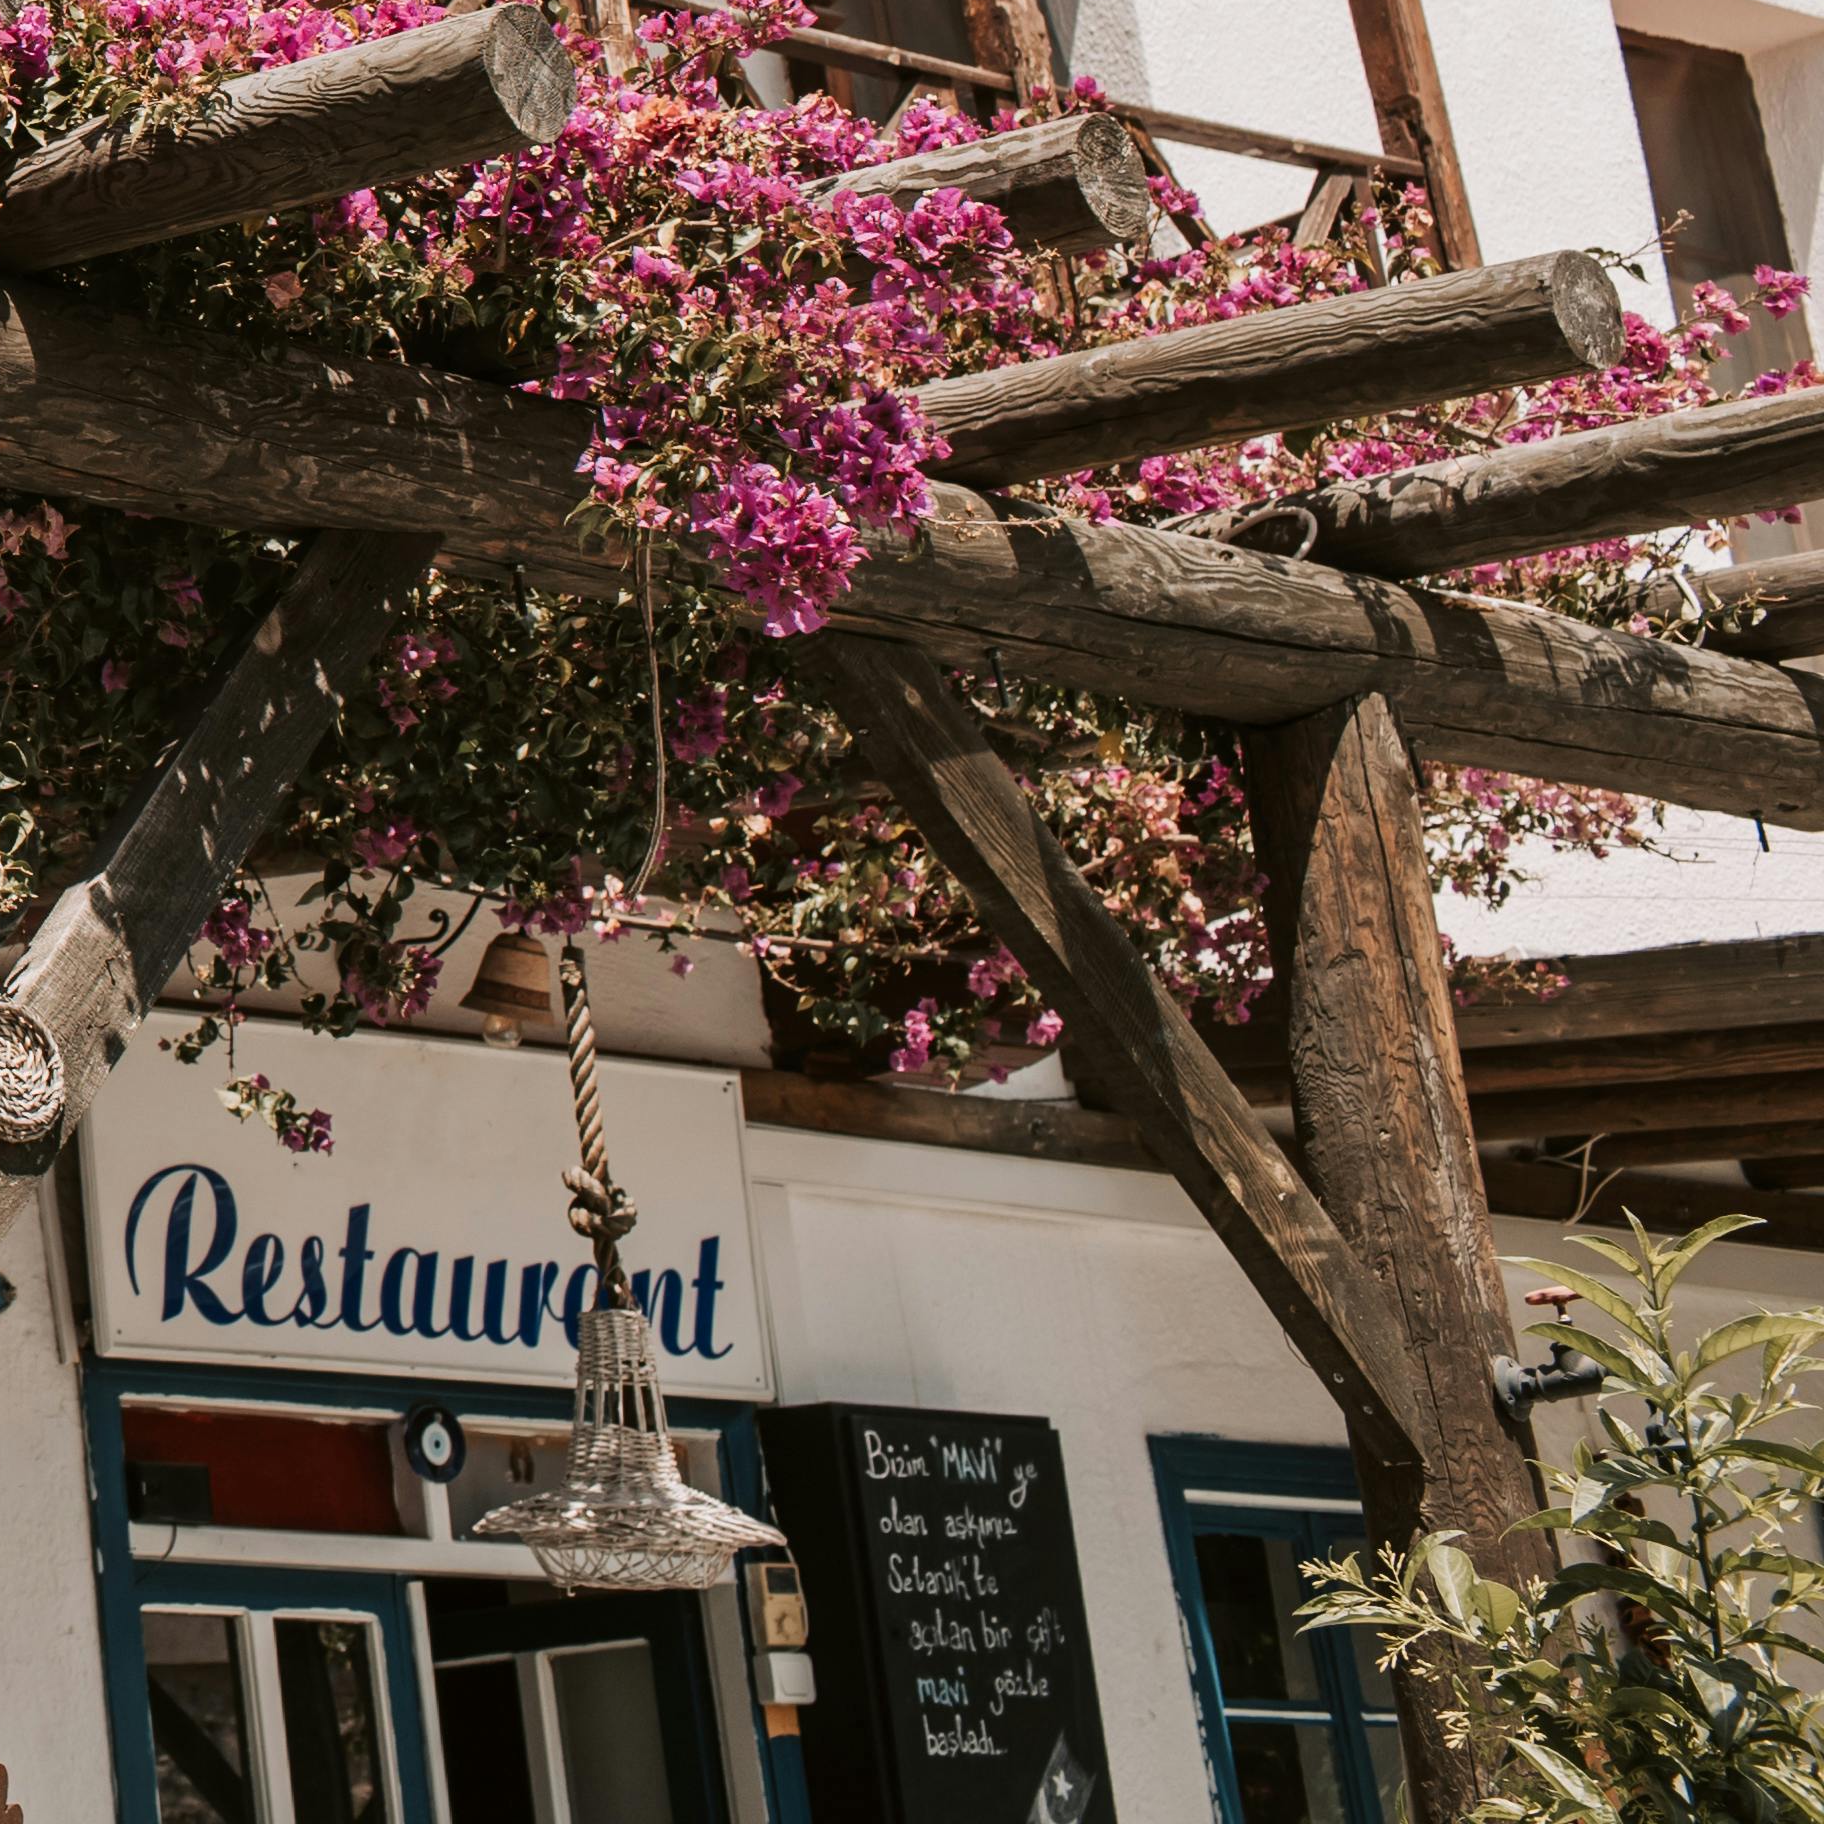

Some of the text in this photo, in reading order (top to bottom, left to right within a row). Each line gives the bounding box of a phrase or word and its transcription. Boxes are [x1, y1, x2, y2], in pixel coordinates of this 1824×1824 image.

[124, 1162, 735, 1361] Restaurant
[863, 1429, 930, 1479] Bizim
[1008, 1462, 1038, 1509] ye
[879, 1496, 929, 1537] olan
[909, 1608, 977, 1657] açılan
[980, 1610, 1013, 1649] bir
[916, 1658, 1049, 1716] mavi gözle
